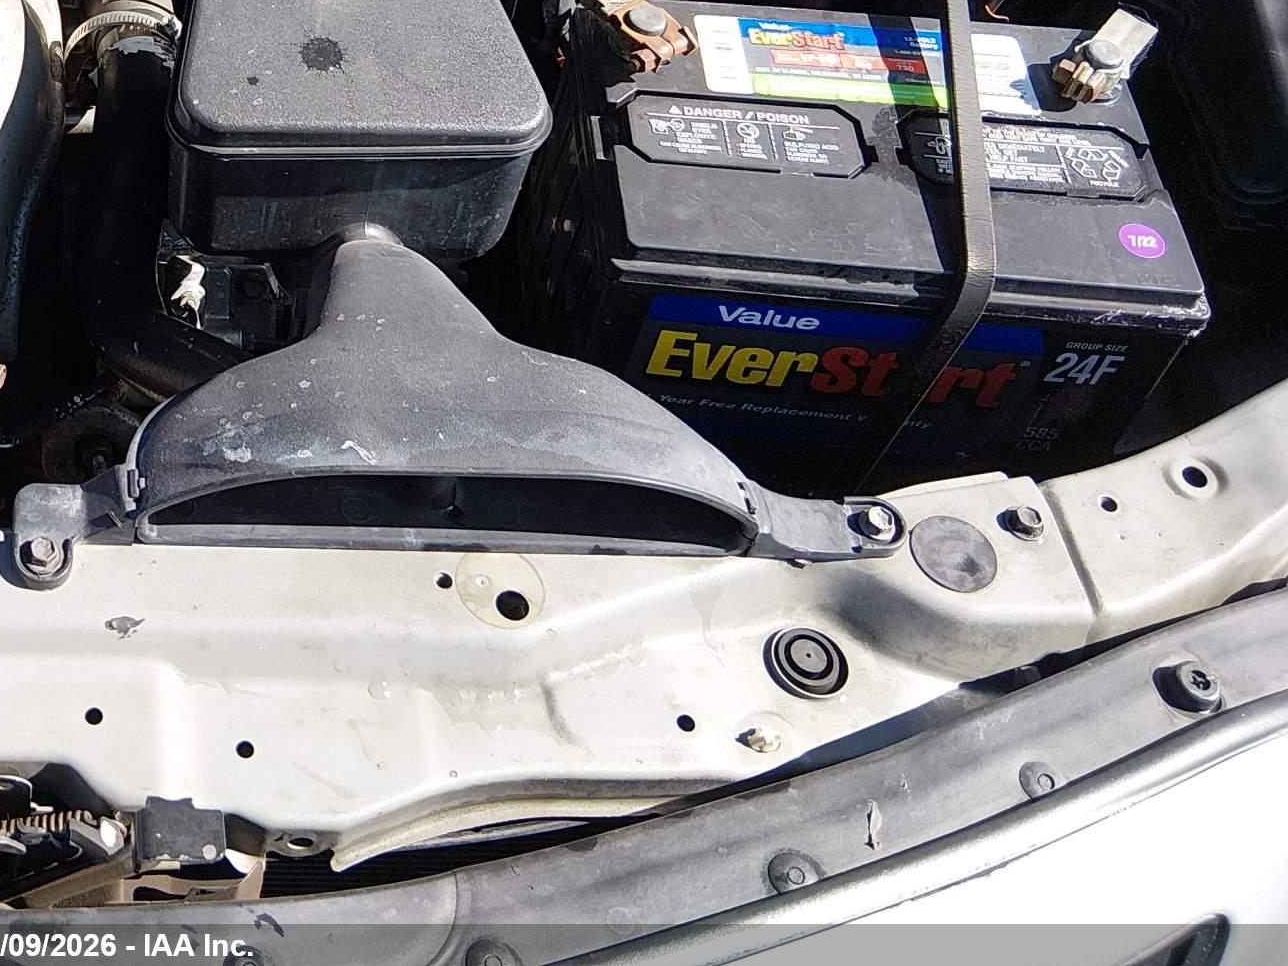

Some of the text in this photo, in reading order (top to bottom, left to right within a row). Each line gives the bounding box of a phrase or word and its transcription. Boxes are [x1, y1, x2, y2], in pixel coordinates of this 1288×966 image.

[748, 28, 846, 51] EverStart
[683, 106, 743, 120] DANGER
[757, 112, 810, 125] POISON
[998, 143, 1045, 153] IMMEDIATELY
[719, 305, 821, 331] Value
[1066, 341, 1130, 353] GROUP SIZE
[645, 329, 1016, 409] EverStrt
[1043, 352, 1126, 385] 24F
[660, 394, 694, 406] Year
[699, 398, 737, 410] Free
[741, 402, 854, 422] Replacement
